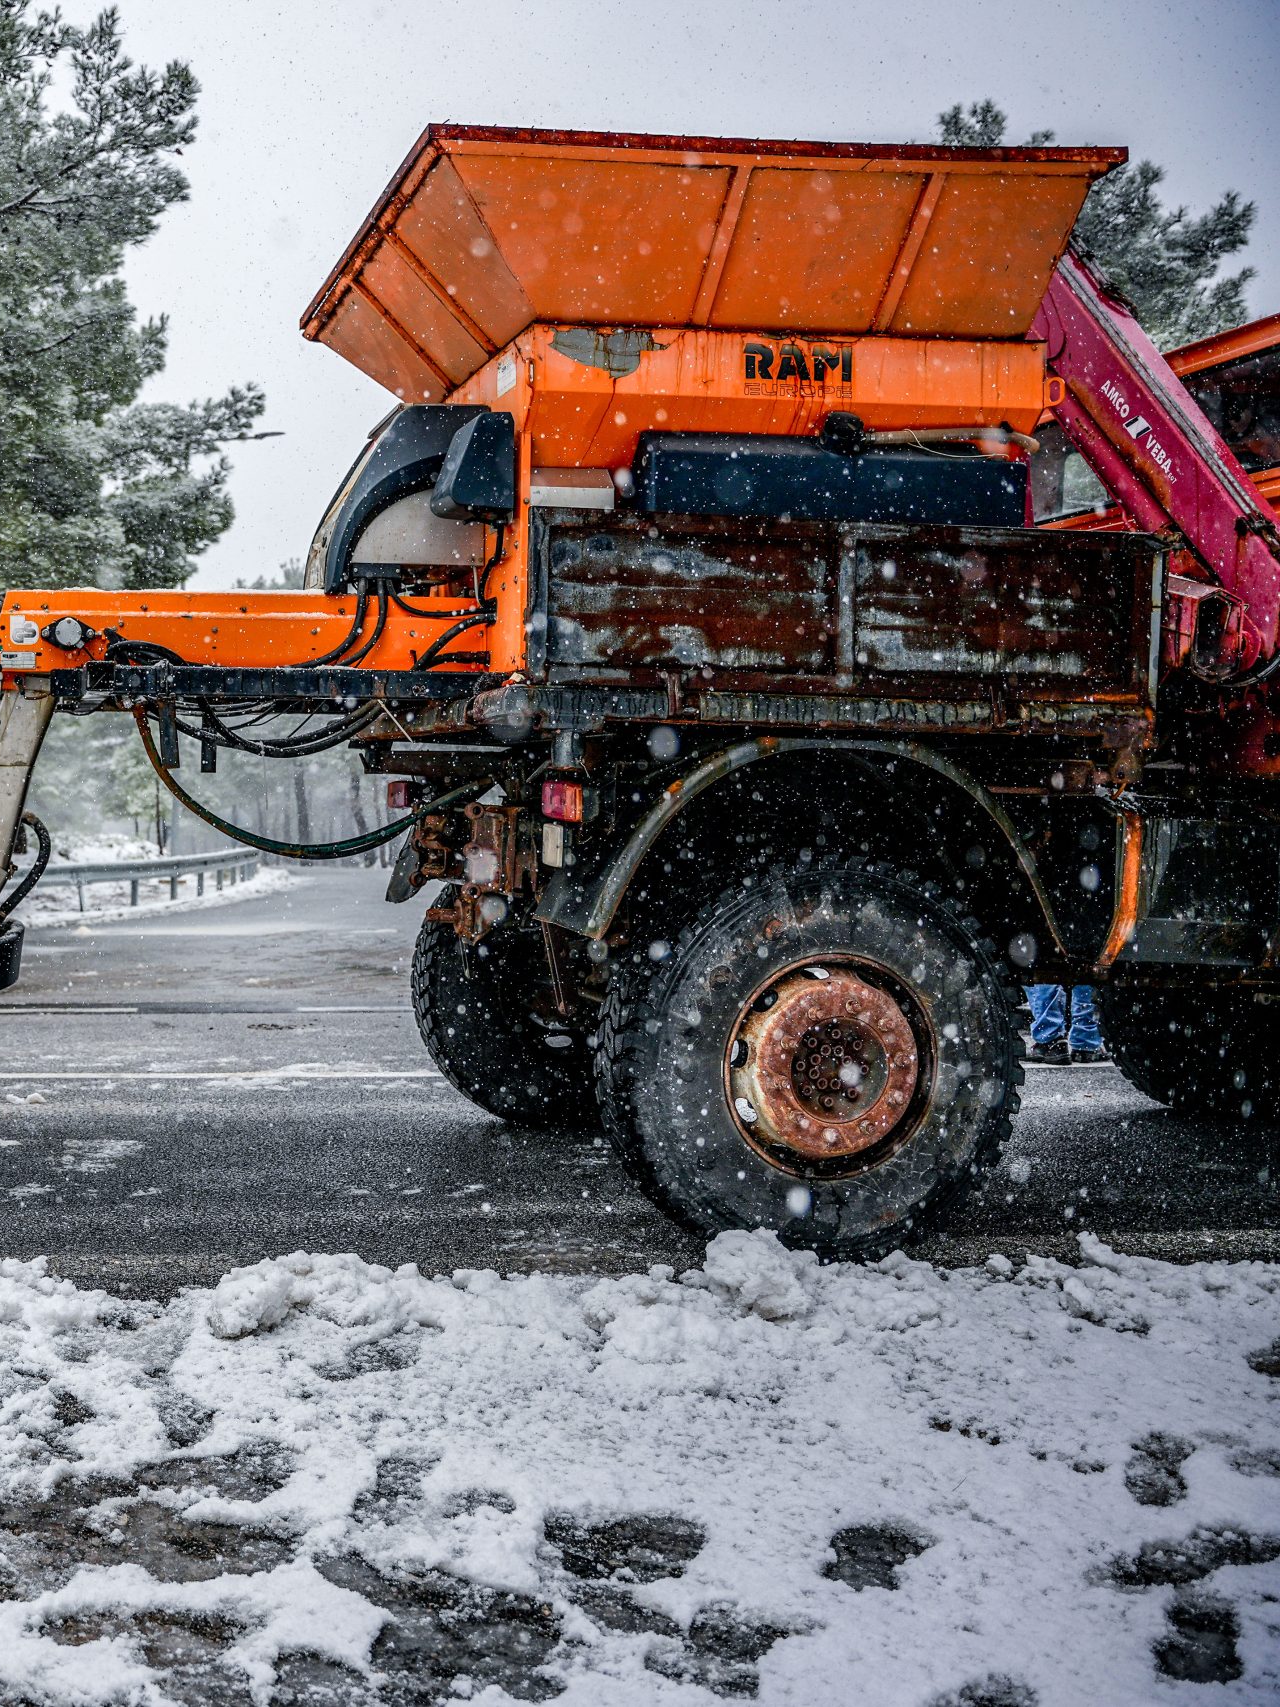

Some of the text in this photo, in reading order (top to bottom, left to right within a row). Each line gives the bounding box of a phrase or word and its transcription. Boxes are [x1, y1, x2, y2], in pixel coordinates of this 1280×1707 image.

[743, 343, 852, 382] RAM
[744, 382, 852, 399] EUROPE
[1099, 379, 1130, 418] AMCO
[1145, 434, 1172, 474] VEBA
